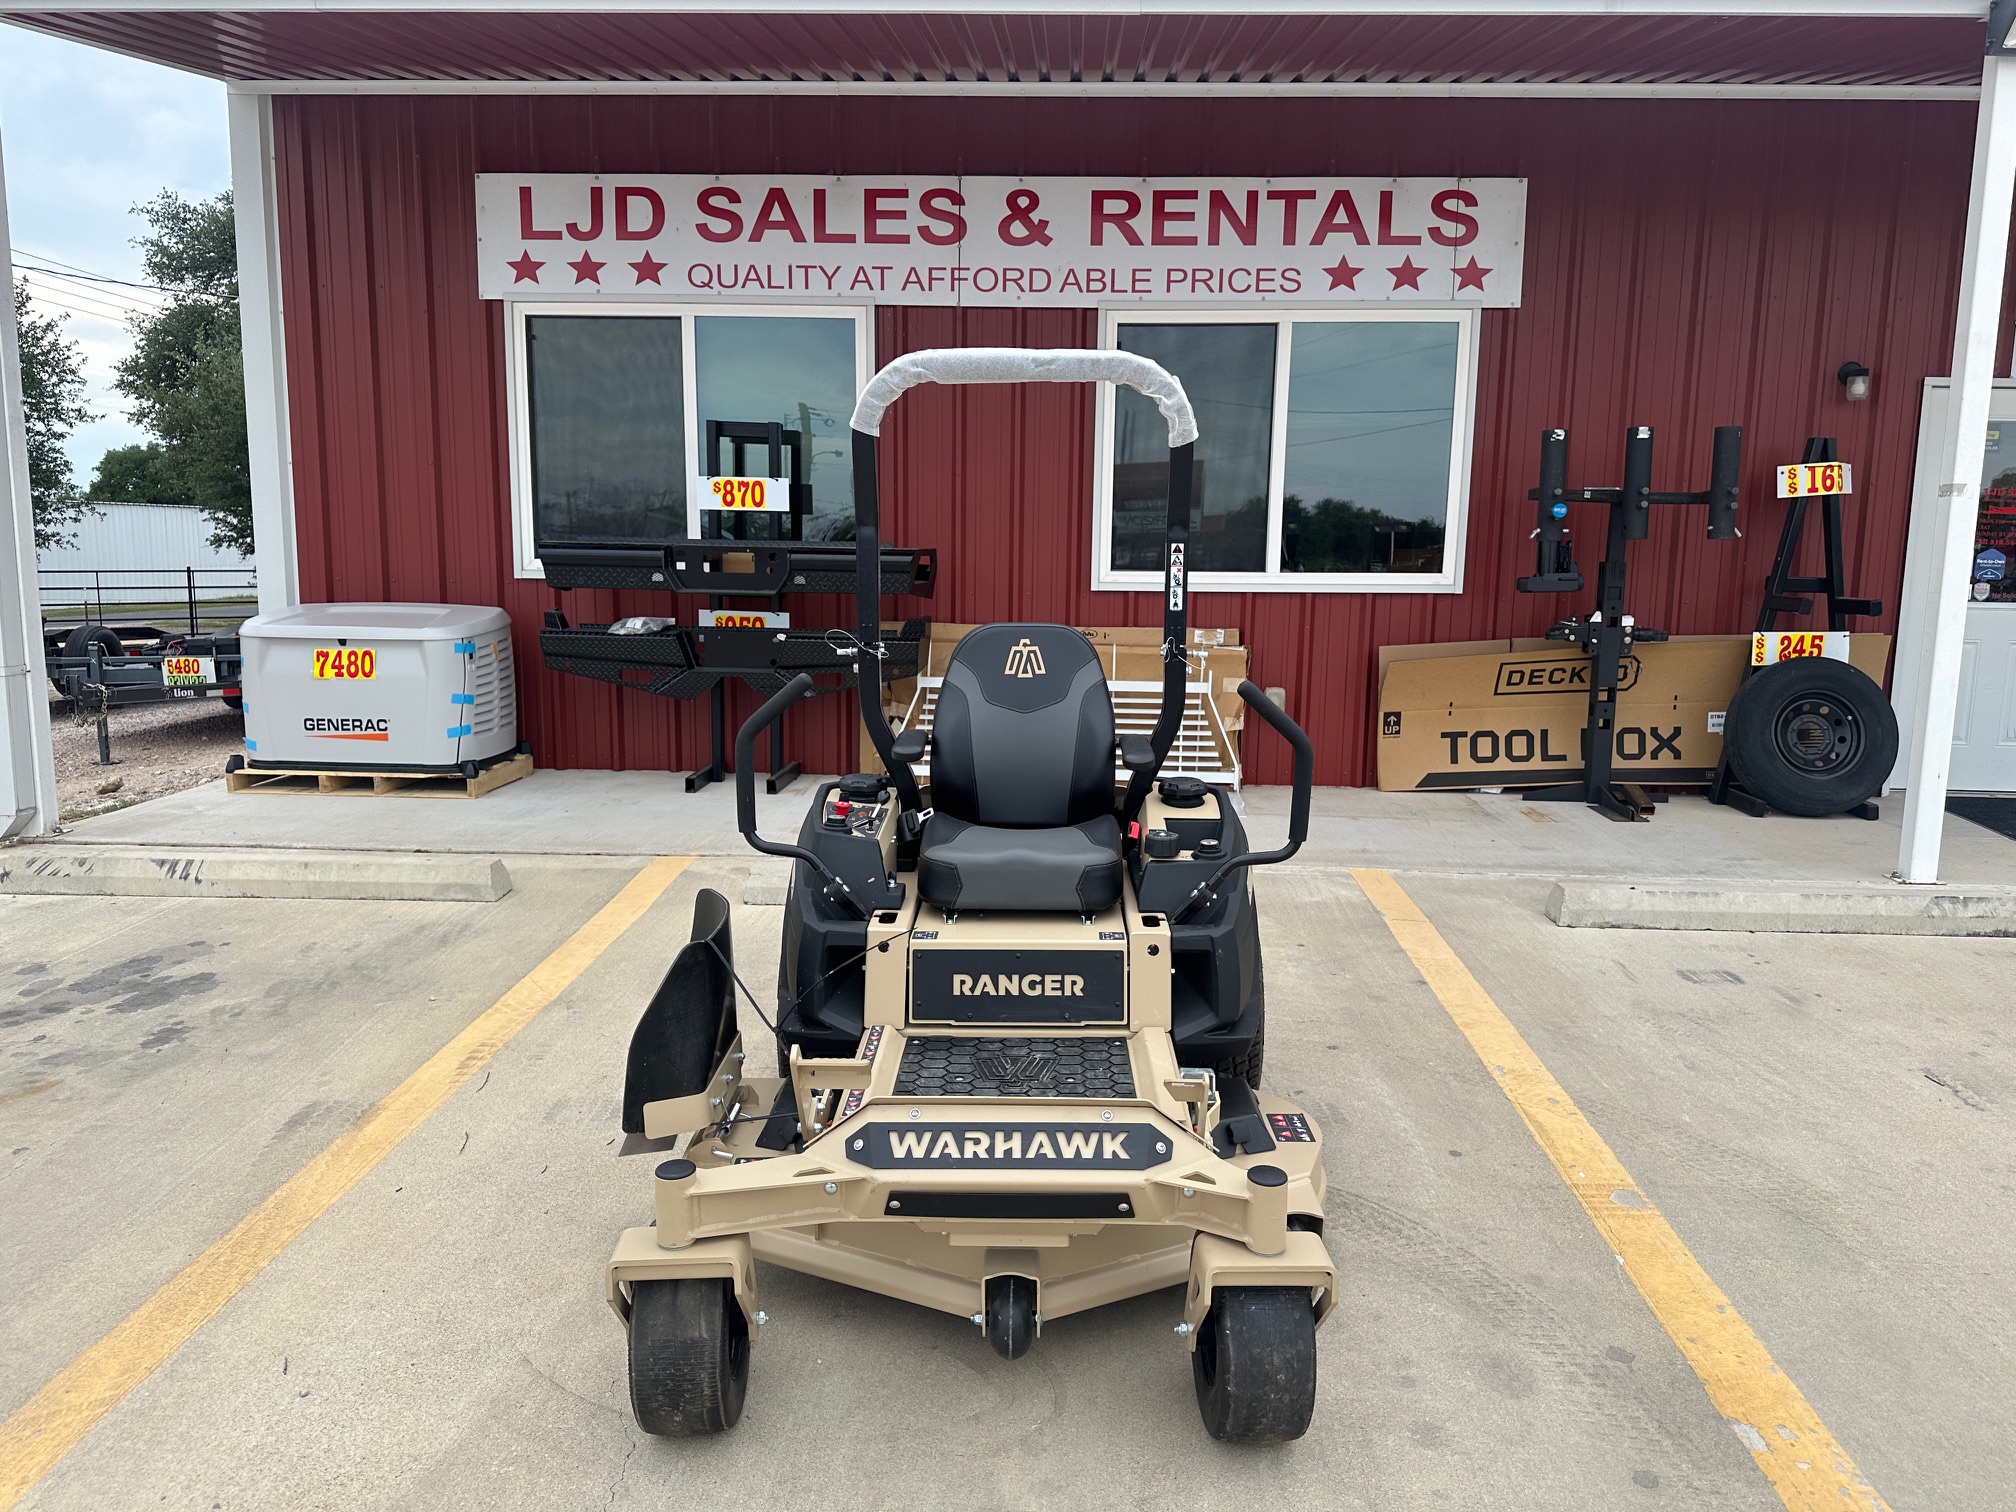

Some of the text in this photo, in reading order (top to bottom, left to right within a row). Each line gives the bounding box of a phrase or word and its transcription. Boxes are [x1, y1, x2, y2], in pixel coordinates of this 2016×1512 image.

[519, 186, 1479, 247] LJD SALES & RENTALS
[687, 263, 841, 290] QUALITY
[849, 265, 893, 291] AT
[1165, 267, 1302, 294] PRICES
[713, 480, 764, 507] $870
[1779, 635, 1823, 661] 245
[167, 659, 200, 675] 5480
[316, 650, 374, 678] 7480
[1506, 664, 1629, 687] DECKD
[304, 718, 388, 732] GENERAC
[1384, 726, 1400, 734] UP
[1441, 726, 1682, 764] TOOL OX
[952, 973, 1085, 997] RANGER
[887, 1130, 1132, 1160] WARHAWK
